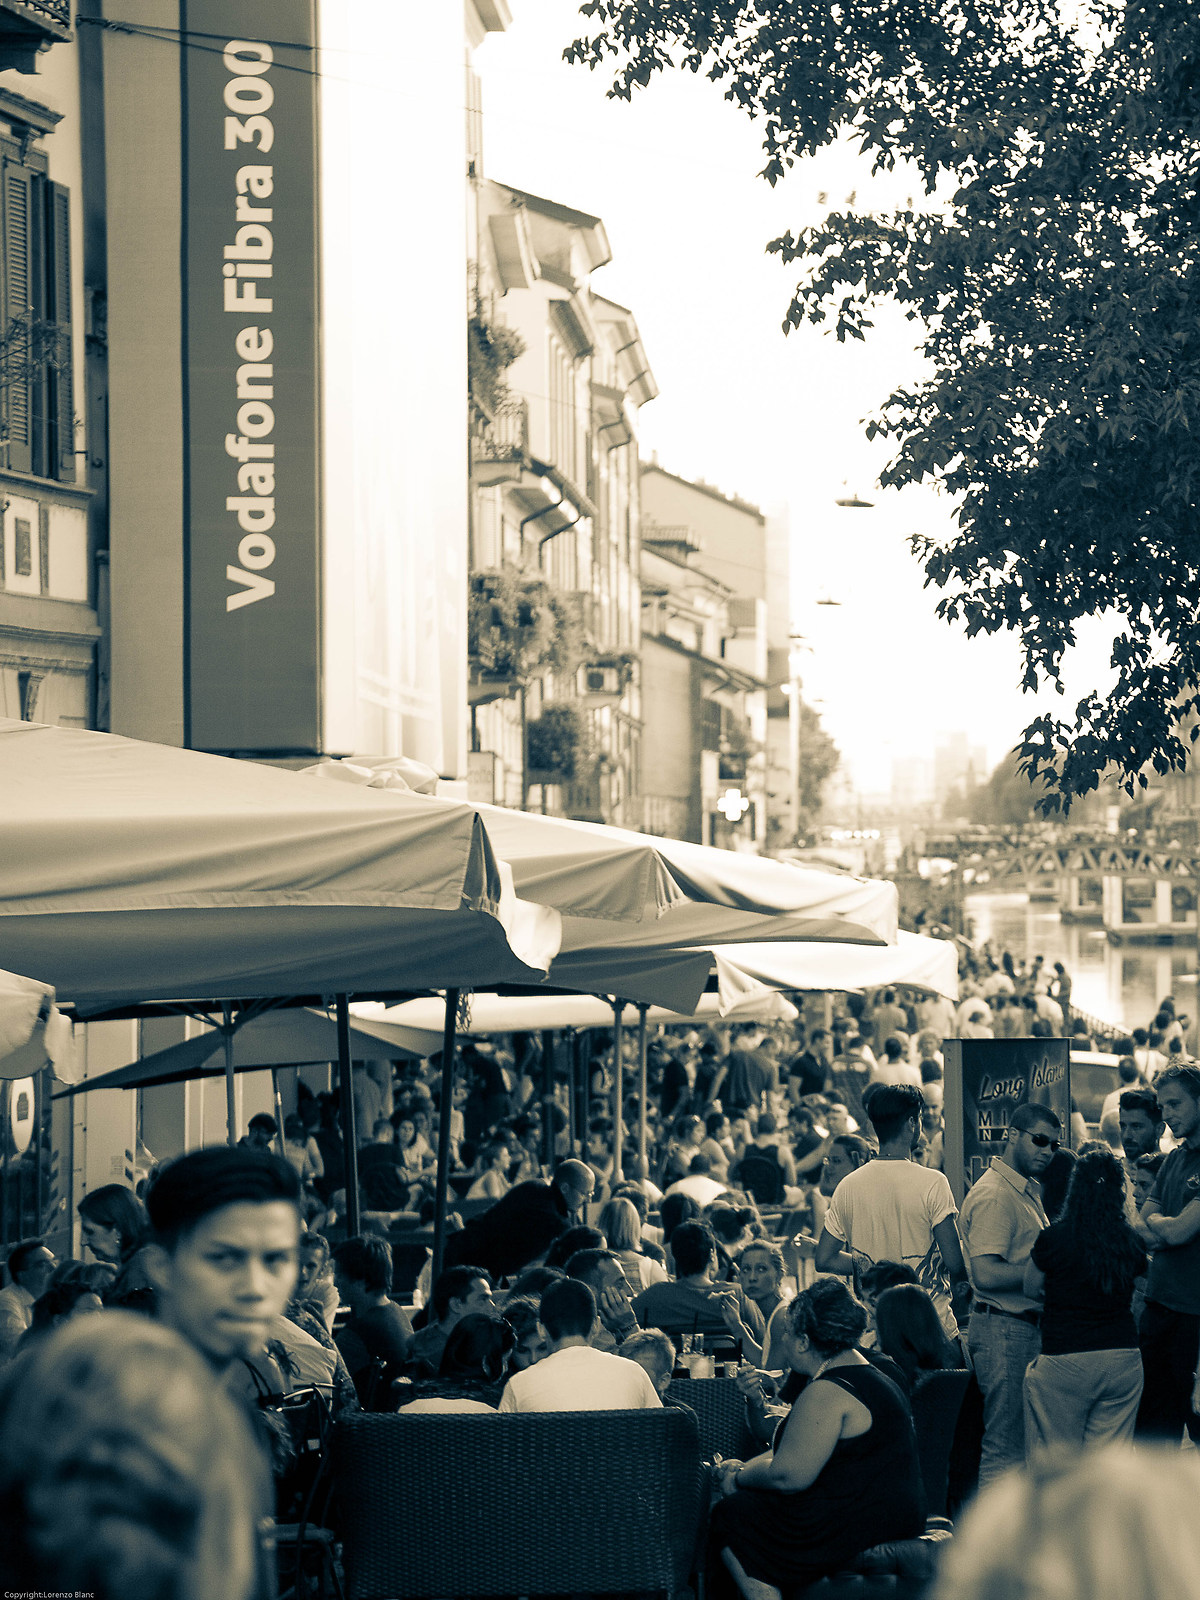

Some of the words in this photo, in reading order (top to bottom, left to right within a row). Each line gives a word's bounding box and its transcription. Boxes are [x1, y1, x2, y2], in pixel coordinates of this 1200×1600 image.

[223, 38, 275, 153] 300
[222, 164, 273, 313] Fibra
[225, 326, 276, 612] Vodafone
[979, 1074, 1025, 1101] Long
